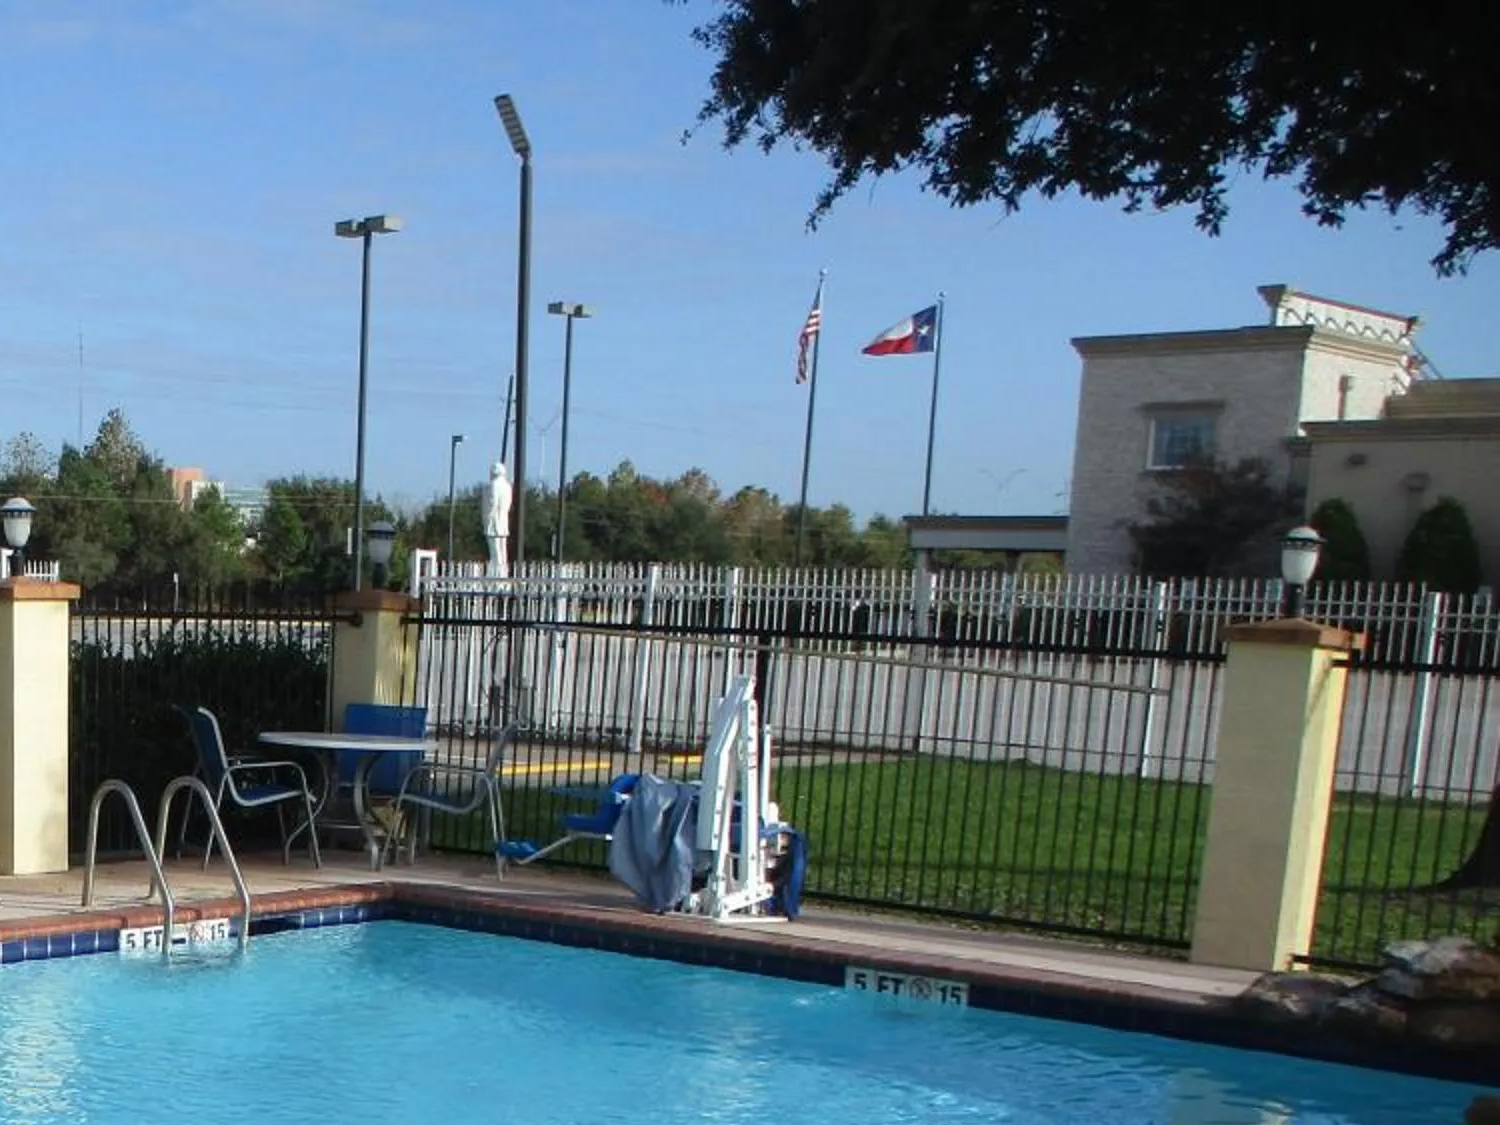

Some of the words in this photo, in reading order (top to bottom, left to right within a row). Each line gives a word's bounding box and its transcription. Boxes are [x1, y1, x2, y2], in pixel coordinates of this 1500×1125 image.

[143, 929, 163, 949] FT
[854, 972, 867, 991] 5
[877, 975, 905, 996] FT
[938, 985, 962, 1005] 15
